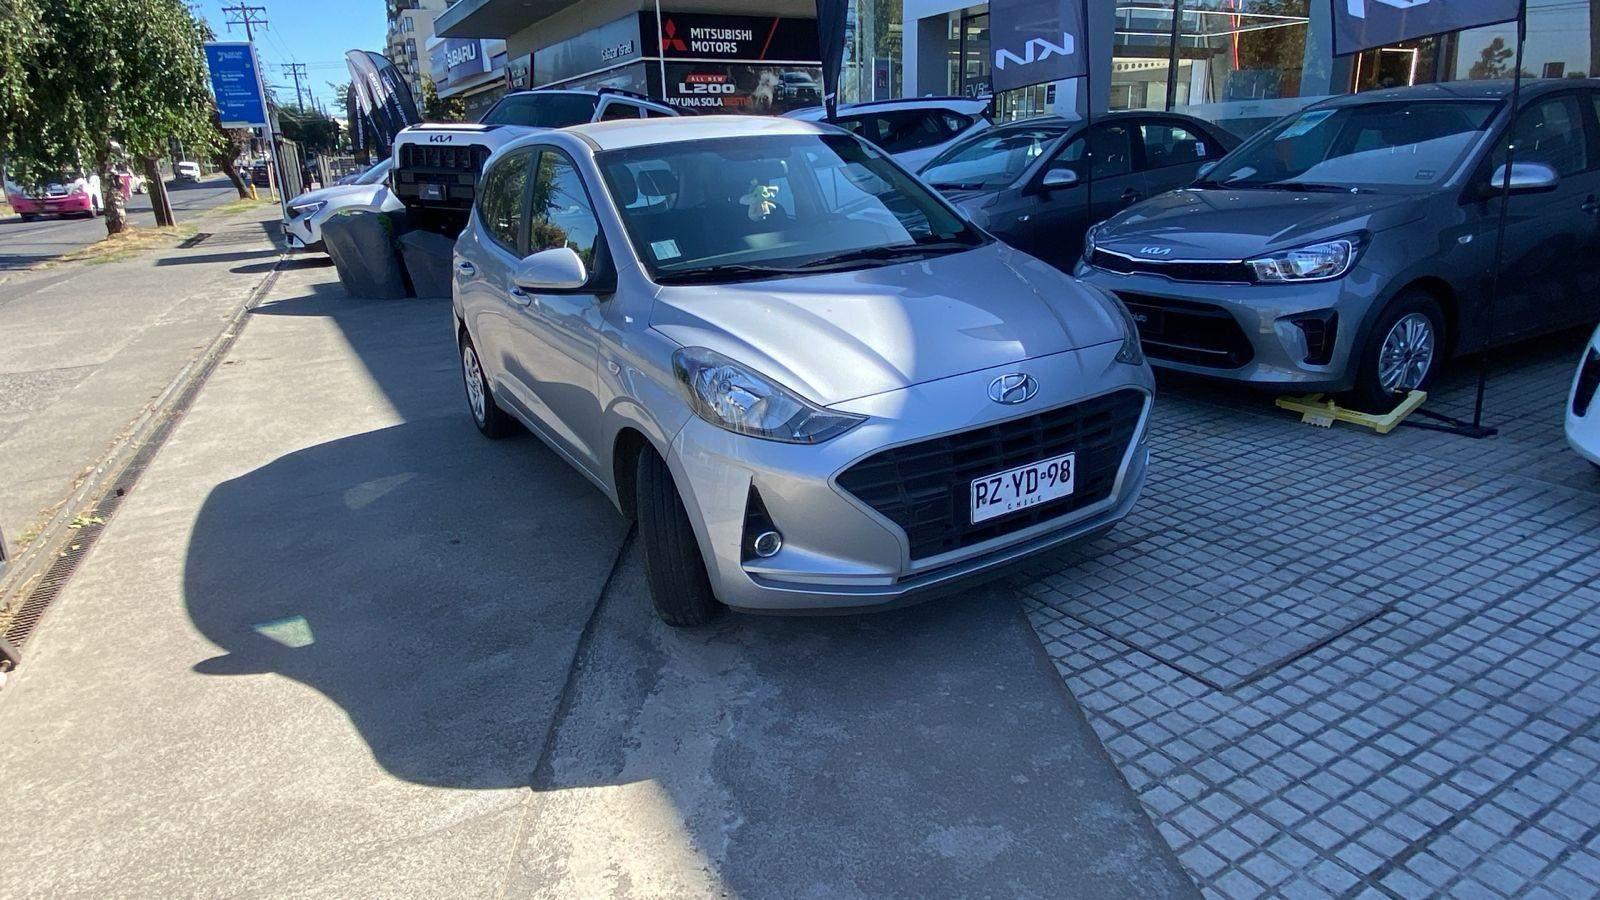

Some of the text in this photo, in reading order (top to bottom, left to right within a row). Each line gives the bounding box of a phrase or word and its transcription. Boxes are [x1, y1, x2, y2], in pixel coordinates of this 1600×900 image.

[690, 27, 753, 41] MITSUBISHI
[691, 41, 738, 53] MOTORS
[447, 43, 476, 69] SUBARU
[678, 82, 736, 94] L200
[681, 97, 701, 106] UNA
[701, 97, 724, 107] SOLA
[430, 134, 453, 143] KIA
[1140, 246, 1172, 255] KIA
[1007, 495, 1042, 510] CHILE
